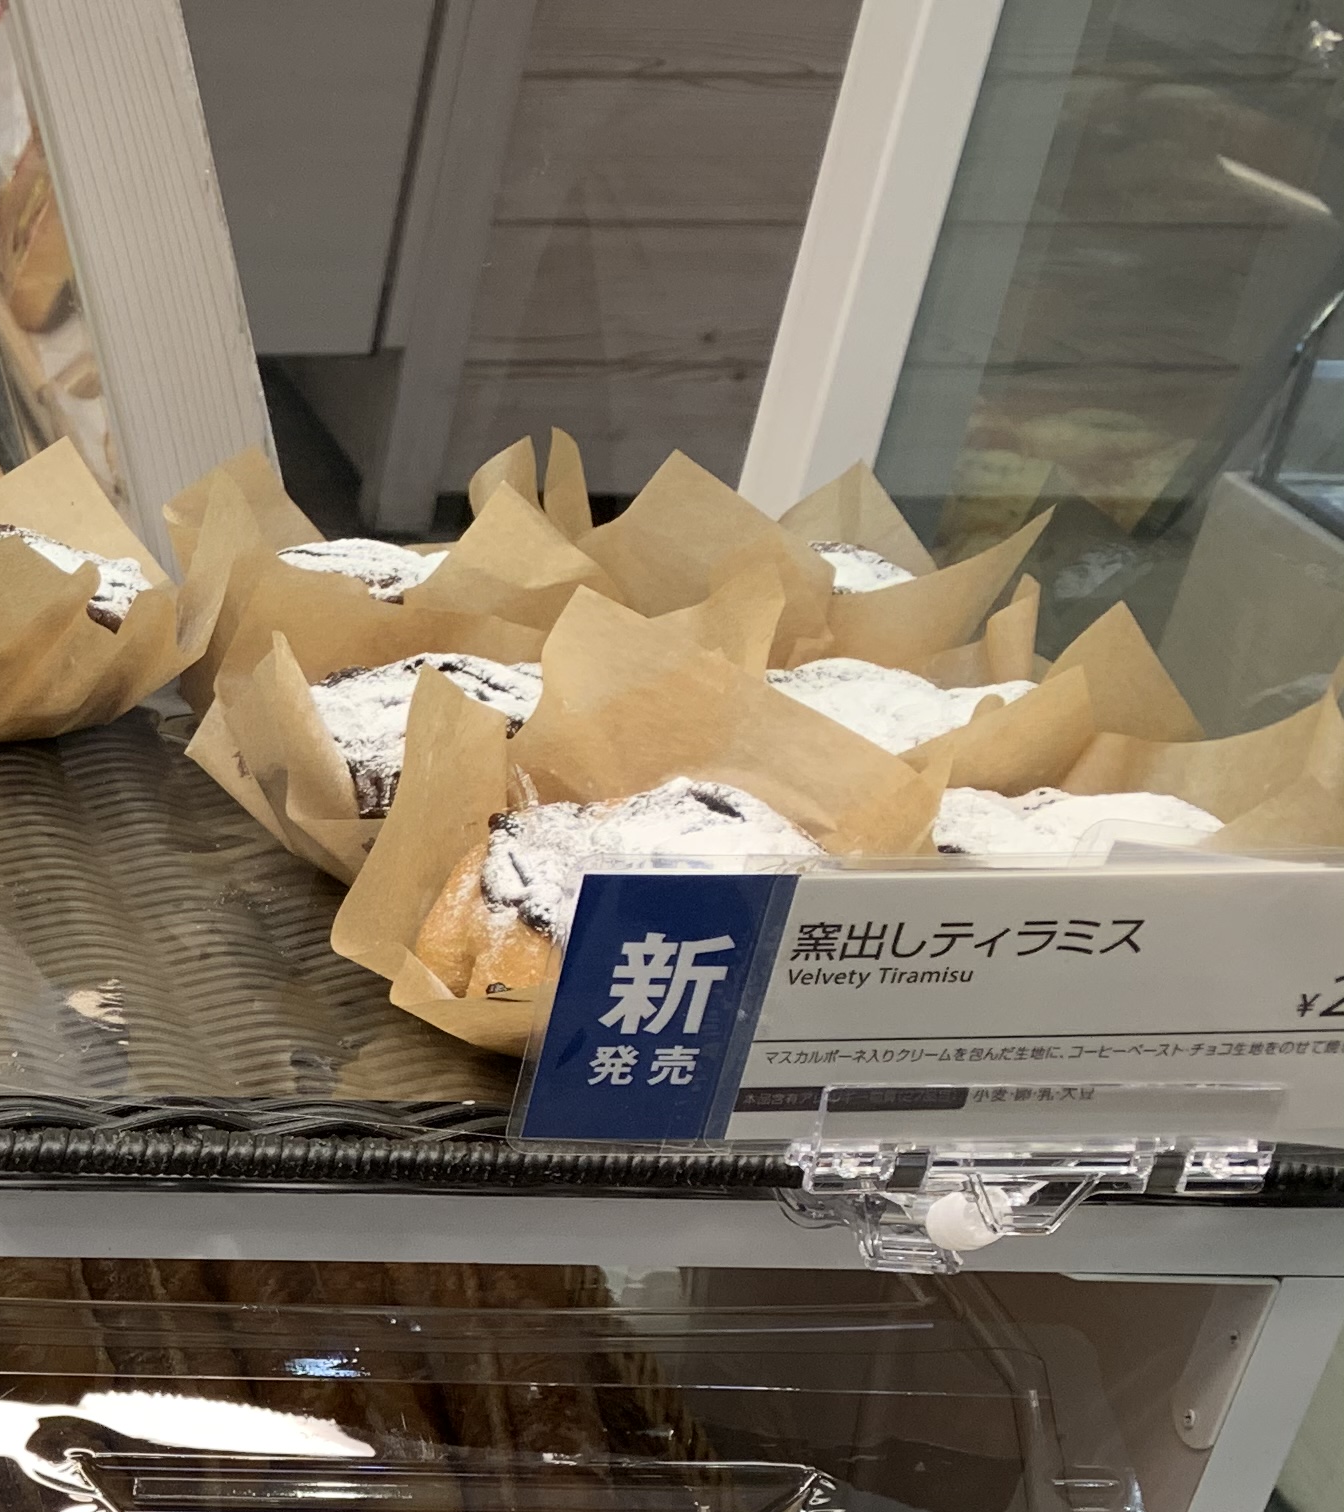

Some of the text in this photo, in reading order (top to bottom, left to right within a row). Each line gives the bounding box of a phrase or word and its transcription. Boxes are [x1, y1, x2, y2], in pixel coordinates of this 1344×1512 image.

[788, 918, 1147, 962] 窯出しティラミス
[598, 932, 736, 1037] 新
[787, 967, 974, 989] Velvety Tiramisu
[588, 1044, 701, 1087] 発売
